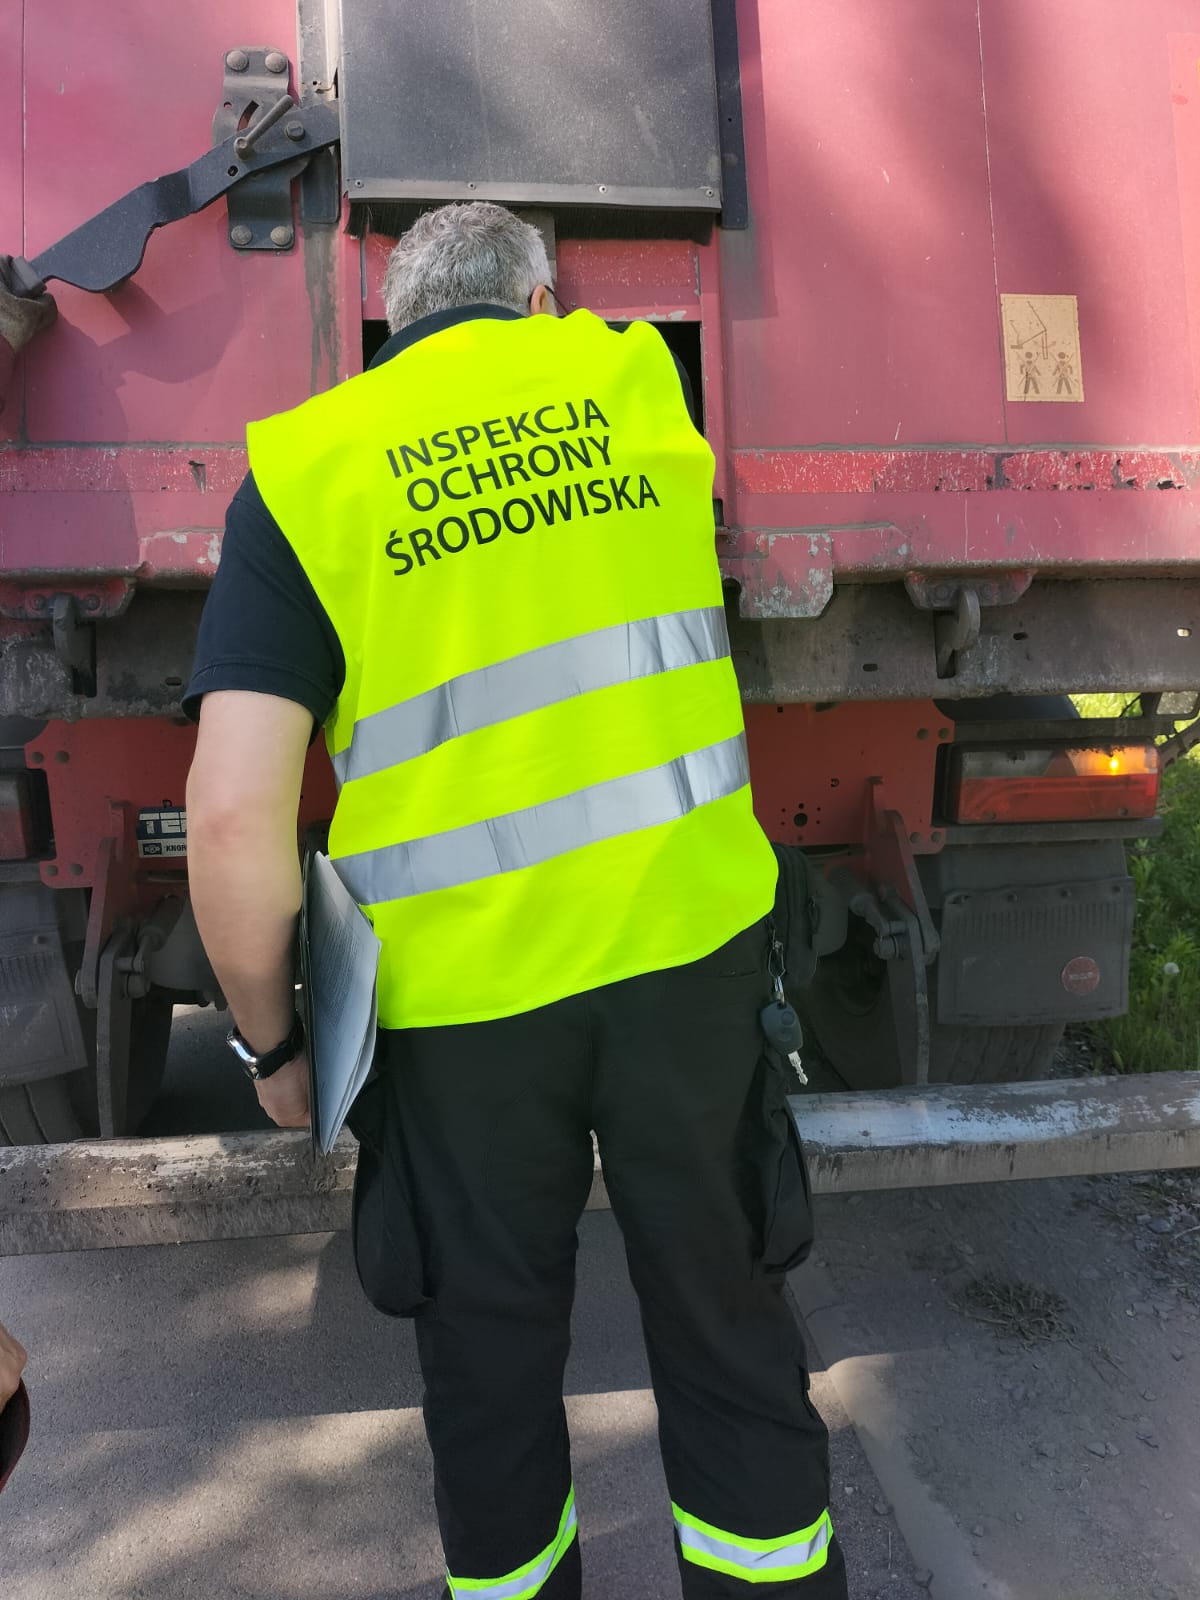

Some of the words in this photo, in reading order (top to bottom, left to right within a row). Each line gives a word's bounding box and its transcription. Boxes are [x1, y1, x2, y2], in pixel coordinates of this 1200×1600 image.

[386, 398, 610, 478] INSPEKCJA
[406, 435, 611, 512] OCHRONY
[385, 474, 661, 576] ŚRODOWISKA
